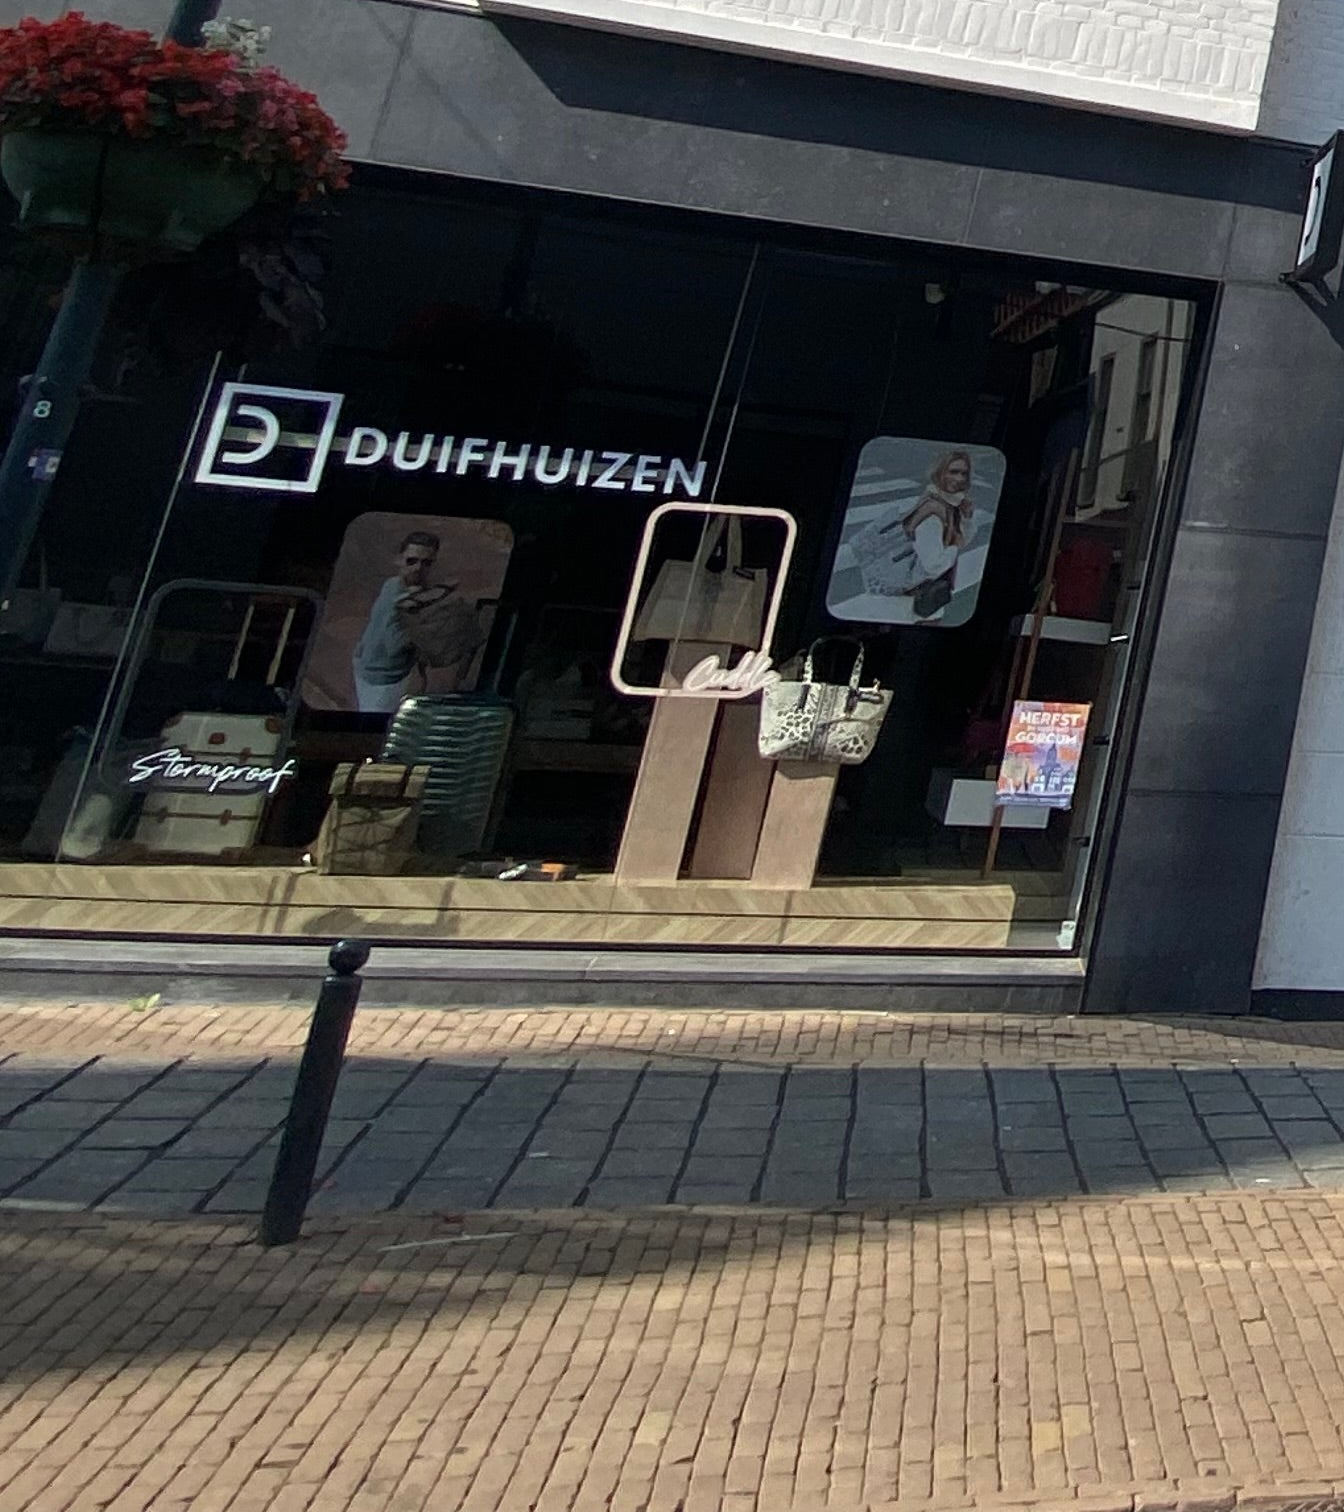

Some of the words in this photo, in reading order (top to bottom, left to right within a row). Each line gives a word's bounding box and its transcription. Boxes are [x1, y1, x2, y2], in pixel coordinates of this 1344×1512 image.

[33, 400, 52, 418] 8
[344, 426, 708, 497] DUIFHUIZEN
[1019, 711, 1081, 727] HERFST
[1015, 731, 1077, 745] GORCUM
[128, 748, 296, 793] Stormproof
